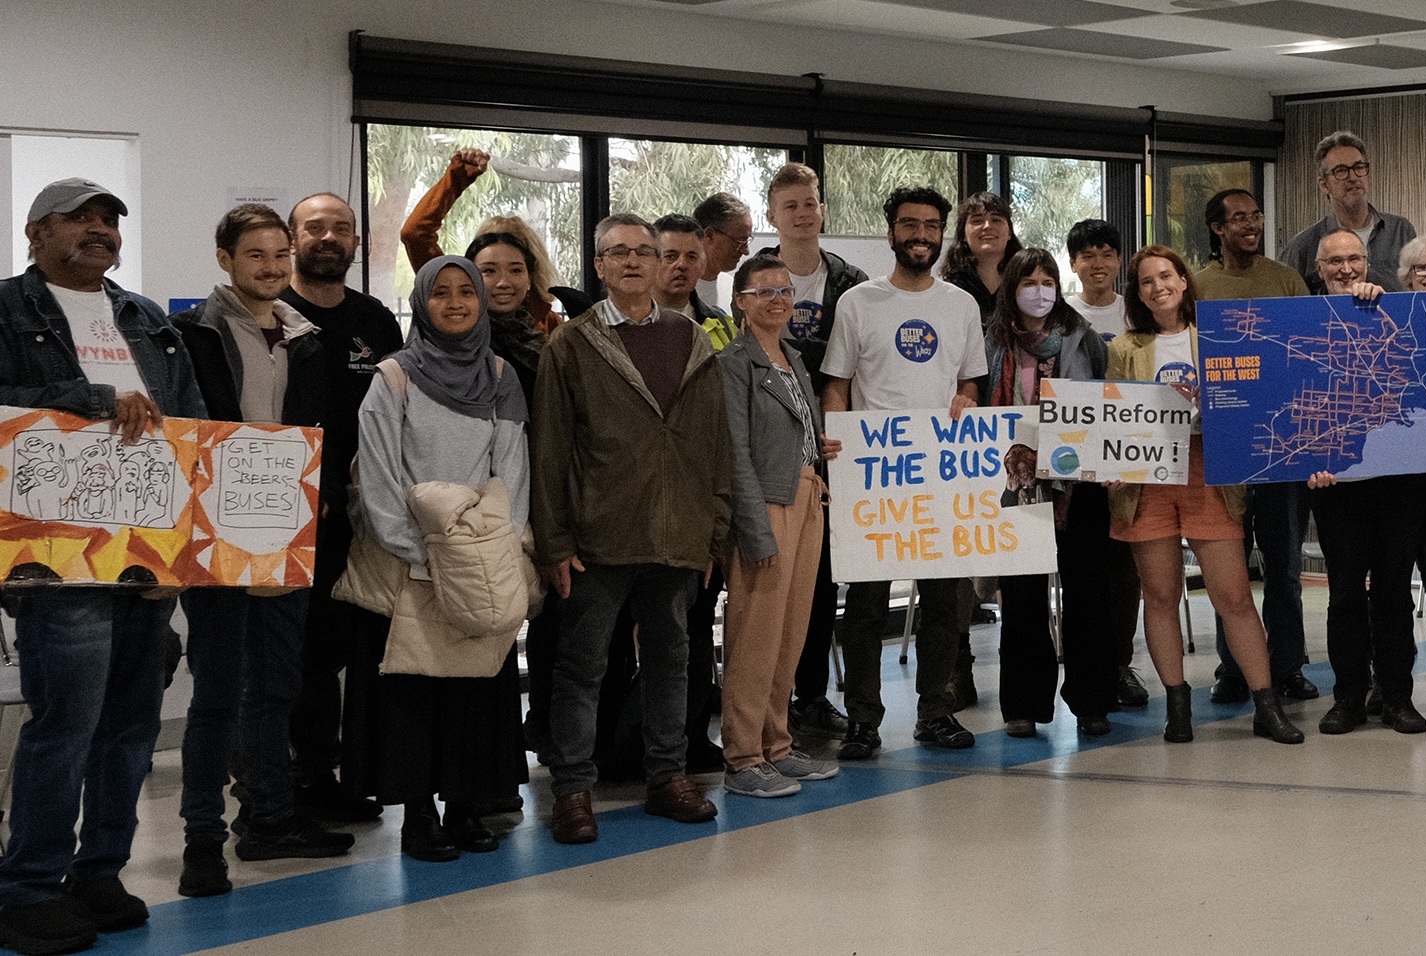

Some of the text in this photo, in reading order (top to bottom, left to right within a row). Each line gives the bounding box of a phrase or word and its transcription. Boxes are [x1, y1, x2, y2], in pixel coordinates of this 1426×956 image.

[900, 328, 923, 336] BETTER
[900, 335, 920, 343] BUSES
[76, 345, 135, 361] WYNB
[1205, 355, 1260, 369] BETTER BUSES
[1206, 368, 1260, 382] FOR THE WEST
[1039, 400, 1192, 425] Bus Reform
[860, 412, 1024, 448] WE WANT
[228, 441, 274, 454] GET
[1103, 439, 1164, 462] Now
[228, 456, 295, 469] ON THE
[854, 447, 1001, 490] THE BUS
[852, 489, 1000, 528] GIVE US
[864, 520, 1019, 561] THE BUS
